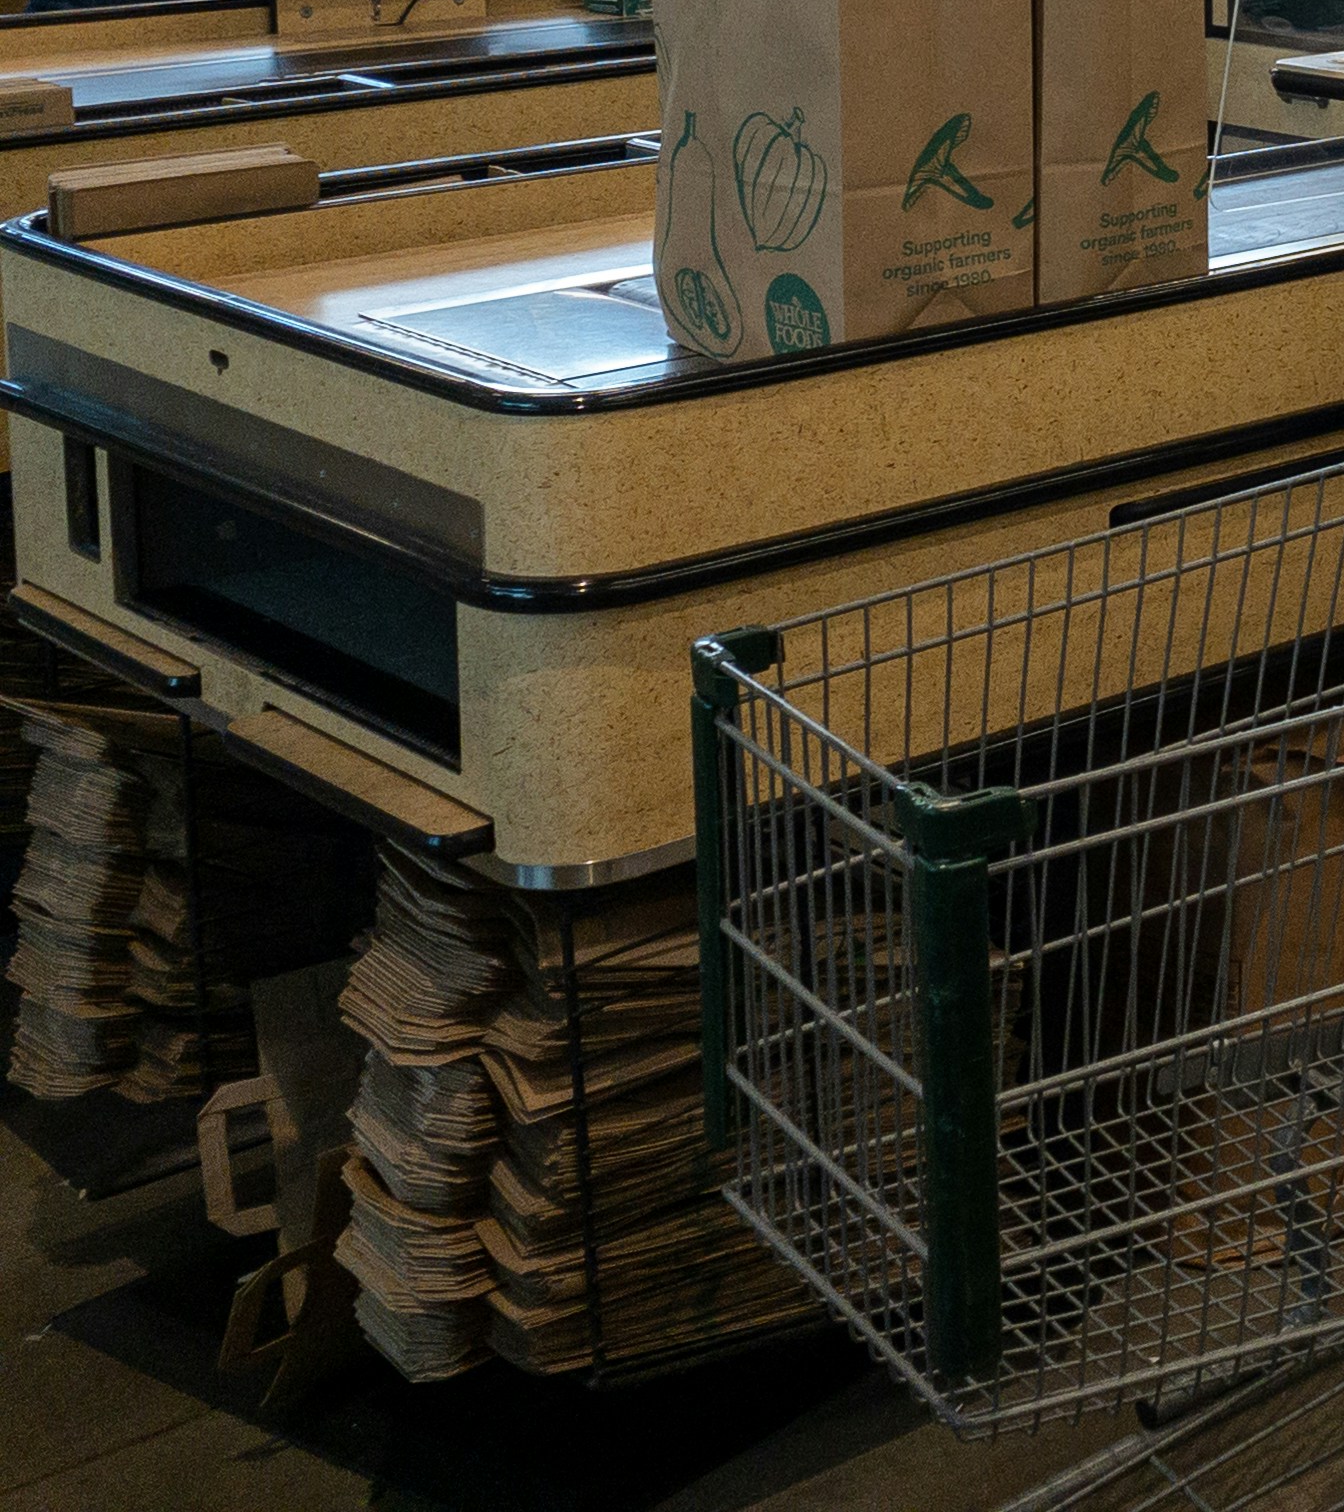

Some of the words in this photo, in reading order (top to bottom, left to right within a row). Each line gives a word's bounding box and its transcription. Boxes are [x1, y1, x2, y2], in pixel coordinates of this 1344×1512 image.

[1100, 203, 1178, 230] Supporting
[902, 231, 992, 257] Supporting
[1080, 229, 1137, 251] organic
[1141, 217, 1193, 239] farmers
[882, 259, 944, 281] organic
[948, 247, 1011, 268] farmers
[1101, 249, 1139, 266] since
[906, 279, 949, 297] since
[954, 269, 995, 289] 1980.
[770, 301, 824, 332] WHOLE
[774, 324, 824, 348] FOODS
